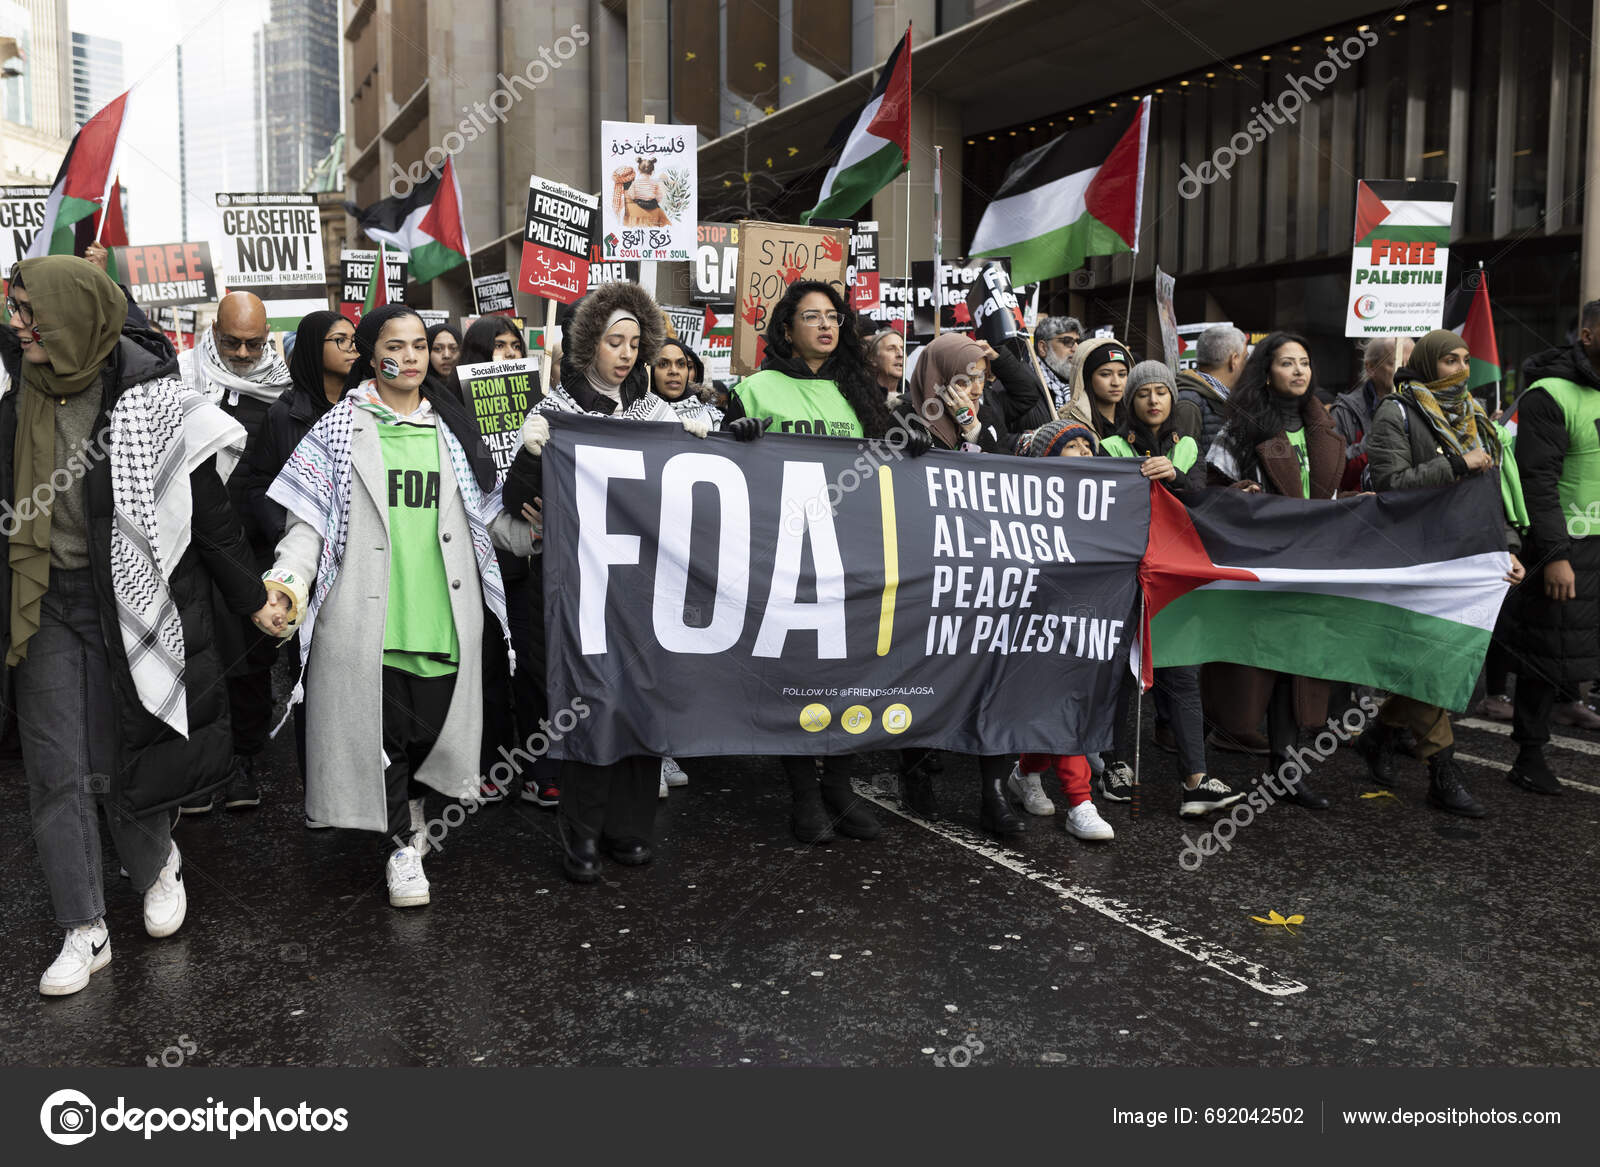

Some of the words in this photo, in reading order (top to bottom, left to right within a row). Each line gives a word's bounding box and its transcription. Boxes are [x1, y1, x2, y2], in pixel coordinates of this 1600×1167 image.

[223, 209, 317, 235] CEASEFIRE
[534, 193, 590, 228] FREEDOM
[528, 220, 589, 256] PALESTINE
[697, 226, 728, 244] STOP
[126, 243, 205, 284] FREE
[537, 250, 576, 274] الحرية
[620, 249, 641, 259] SOUL
[642, 249, 653, 258] OF
[655, 249, 667, 258] MY
[669, 249, 690, 259] SOUL
[760, 239, 828, 270] STOP
[1370, 239, 1438, 266] FREE
[347, 262, 401, 281] FREEM
[588, 262, 630, 285] RAEL
[696, 245, 739, 294] GA
[1355, 269, 1444, 285] PALESTINE
[131, 280, 208, 302] PALESTINE
[344, 285, 404, 303] PALNE
[478, 282, 509, 298] FREEDOM
[529, 271, 580, 293] لفلسطين
[671, 315, 702, 331] SEFIRE
[470, 377, 506, 398] FROM
[508, 374, 531, 393] THE
[474, 396, 510, 416] RIVER
[512, 394, 528, 411] TO
[477, 416, 501, 434] THE
[503, 411, 525, 432] SEA
[388, 469, 440, 509] FOA
[925, 466, 1065, 519] FRIENDS
[1077, 479, 1117, 521] OF
[574, 444, 848, 660] FOA
[933, 515, 1076, 565] AL-AQSA
[931, 565, 1041, 609] PEACE
[925, 615, 963, 656] IN
[970, 613, 1124, 661] PALESTINE
[782, 687, 824, 697] FOLLOW
[825, 687, 838, 697] US
[839, 686, 935, 698] @FRIENDSOFALAQSA
